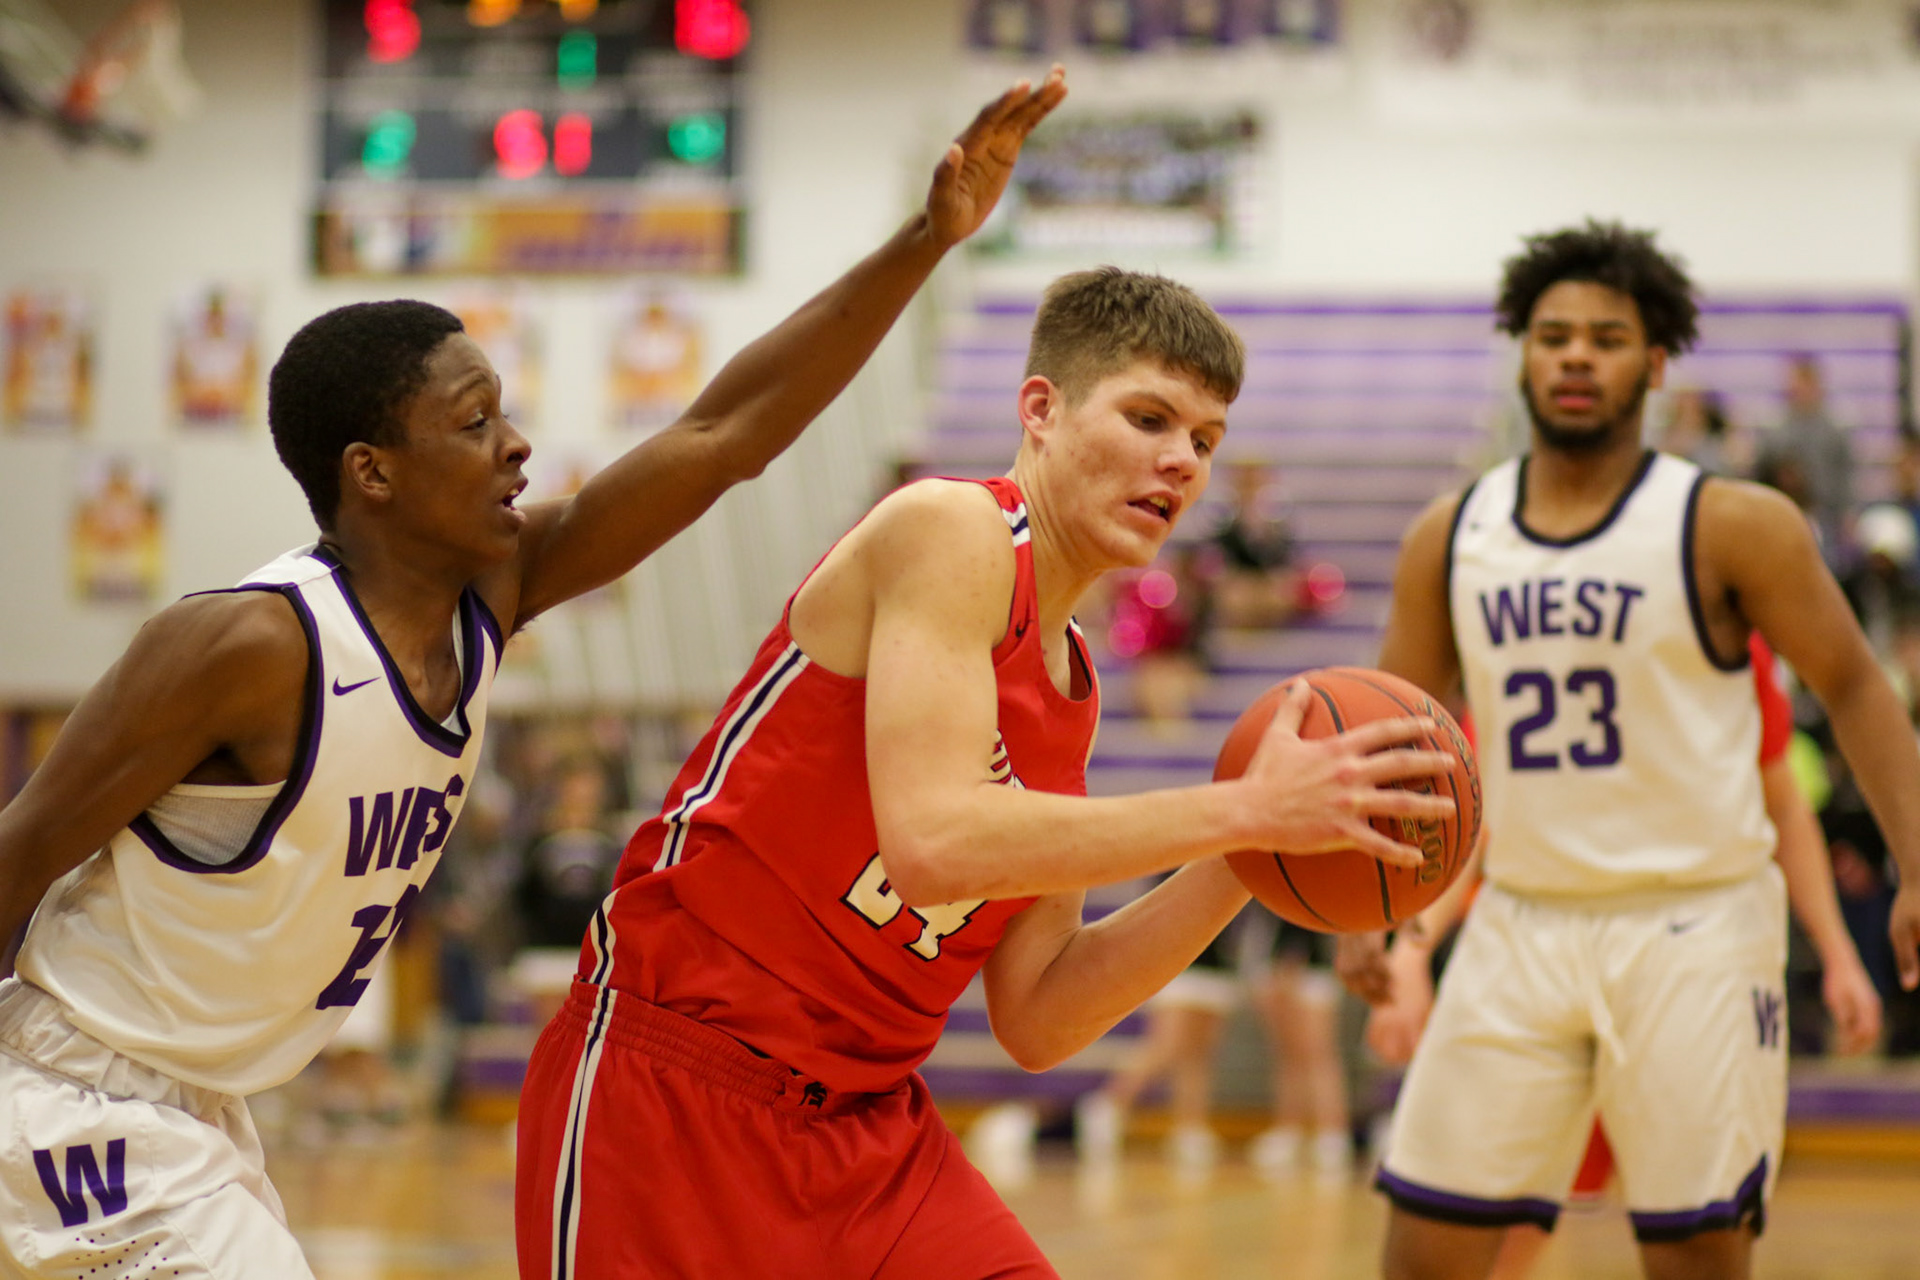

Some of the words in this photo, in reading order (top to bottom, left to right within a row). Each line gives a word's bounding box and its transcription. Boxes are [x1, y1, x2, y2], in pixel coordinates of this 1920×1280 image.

[1480, 578, 1645, 646] WEST
[1505, 668, 1621, 770] 23
[344, 774, 464, 877] WES
[32, 1137, 128, 1228] W
